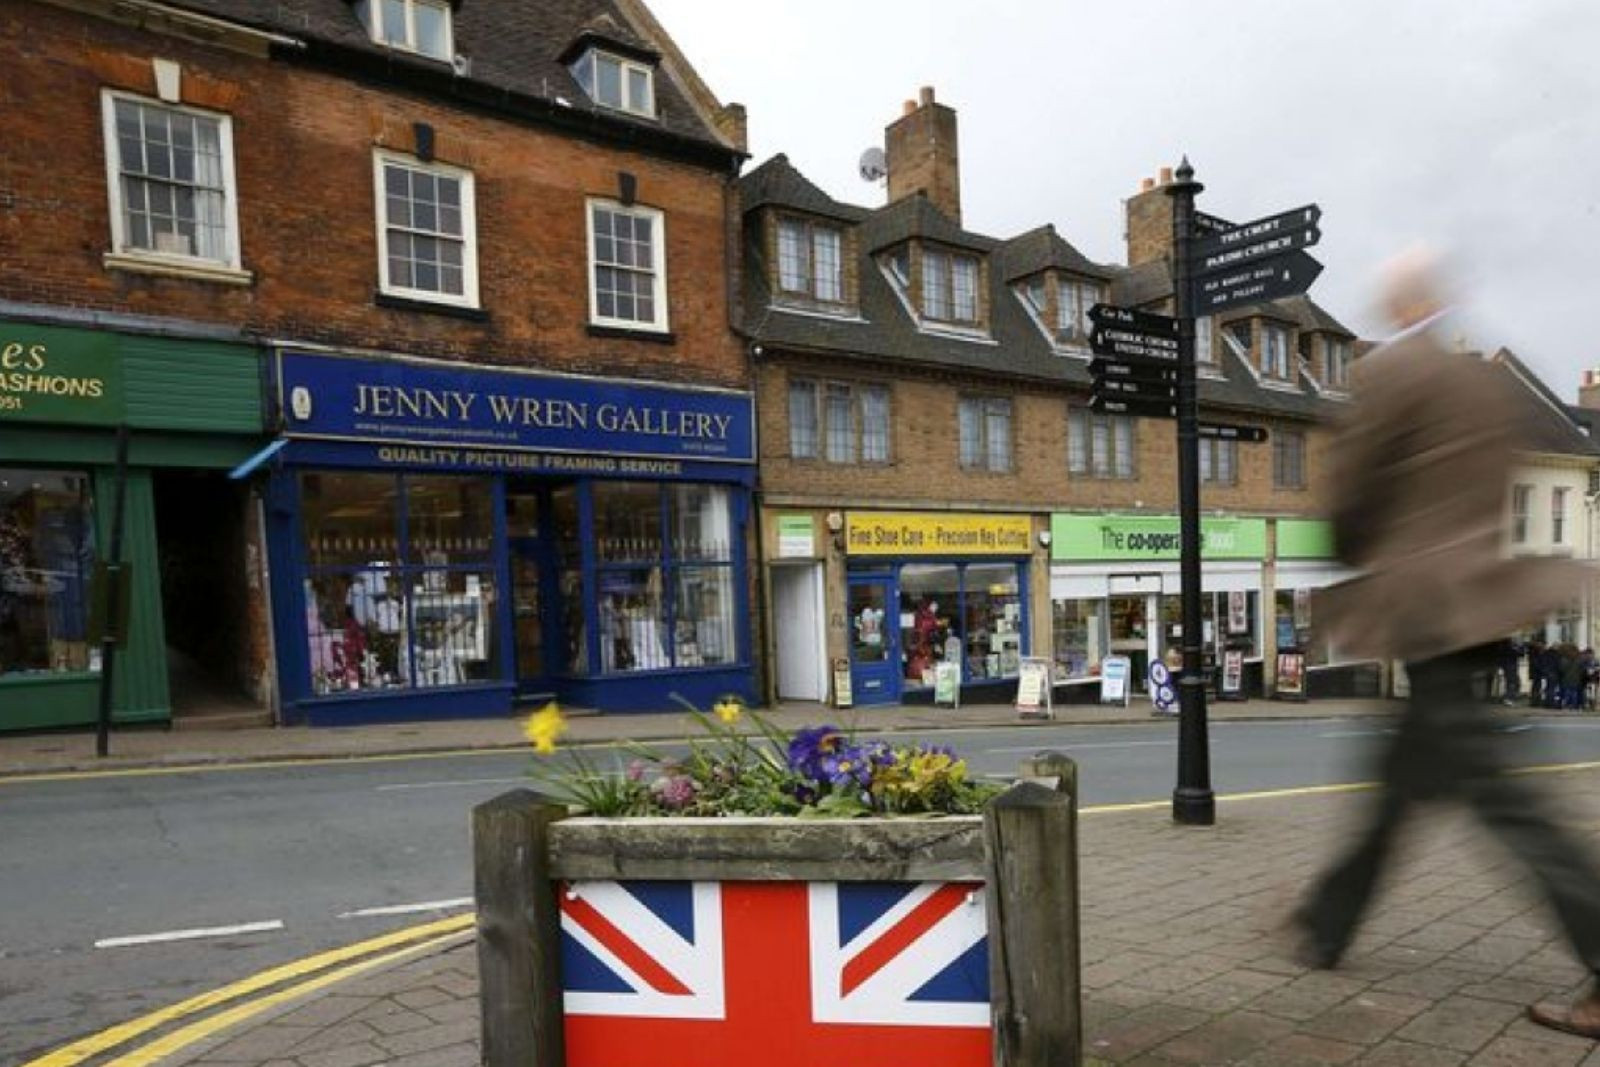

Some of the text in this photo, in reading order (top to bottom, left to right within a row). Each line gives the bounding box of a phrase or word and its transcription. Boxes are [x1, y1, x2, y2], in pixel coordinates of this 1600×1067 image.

[354, 384, 733, 439] JENNY WREN GALLERY
[378, 447, 683, 475] QUALITY PICTURE FRAMING SERVICE
[850, 525, 871, 545] Fine
[874, 526, 898, 547] Shoe
[901, 526, 924, 546] Care
[937, 525, 978, 546] Precision
[980, 527, 996, 549] Key
[997, 527, 1029, 550] Cutting
[1101, 526, 1124, 549] The
